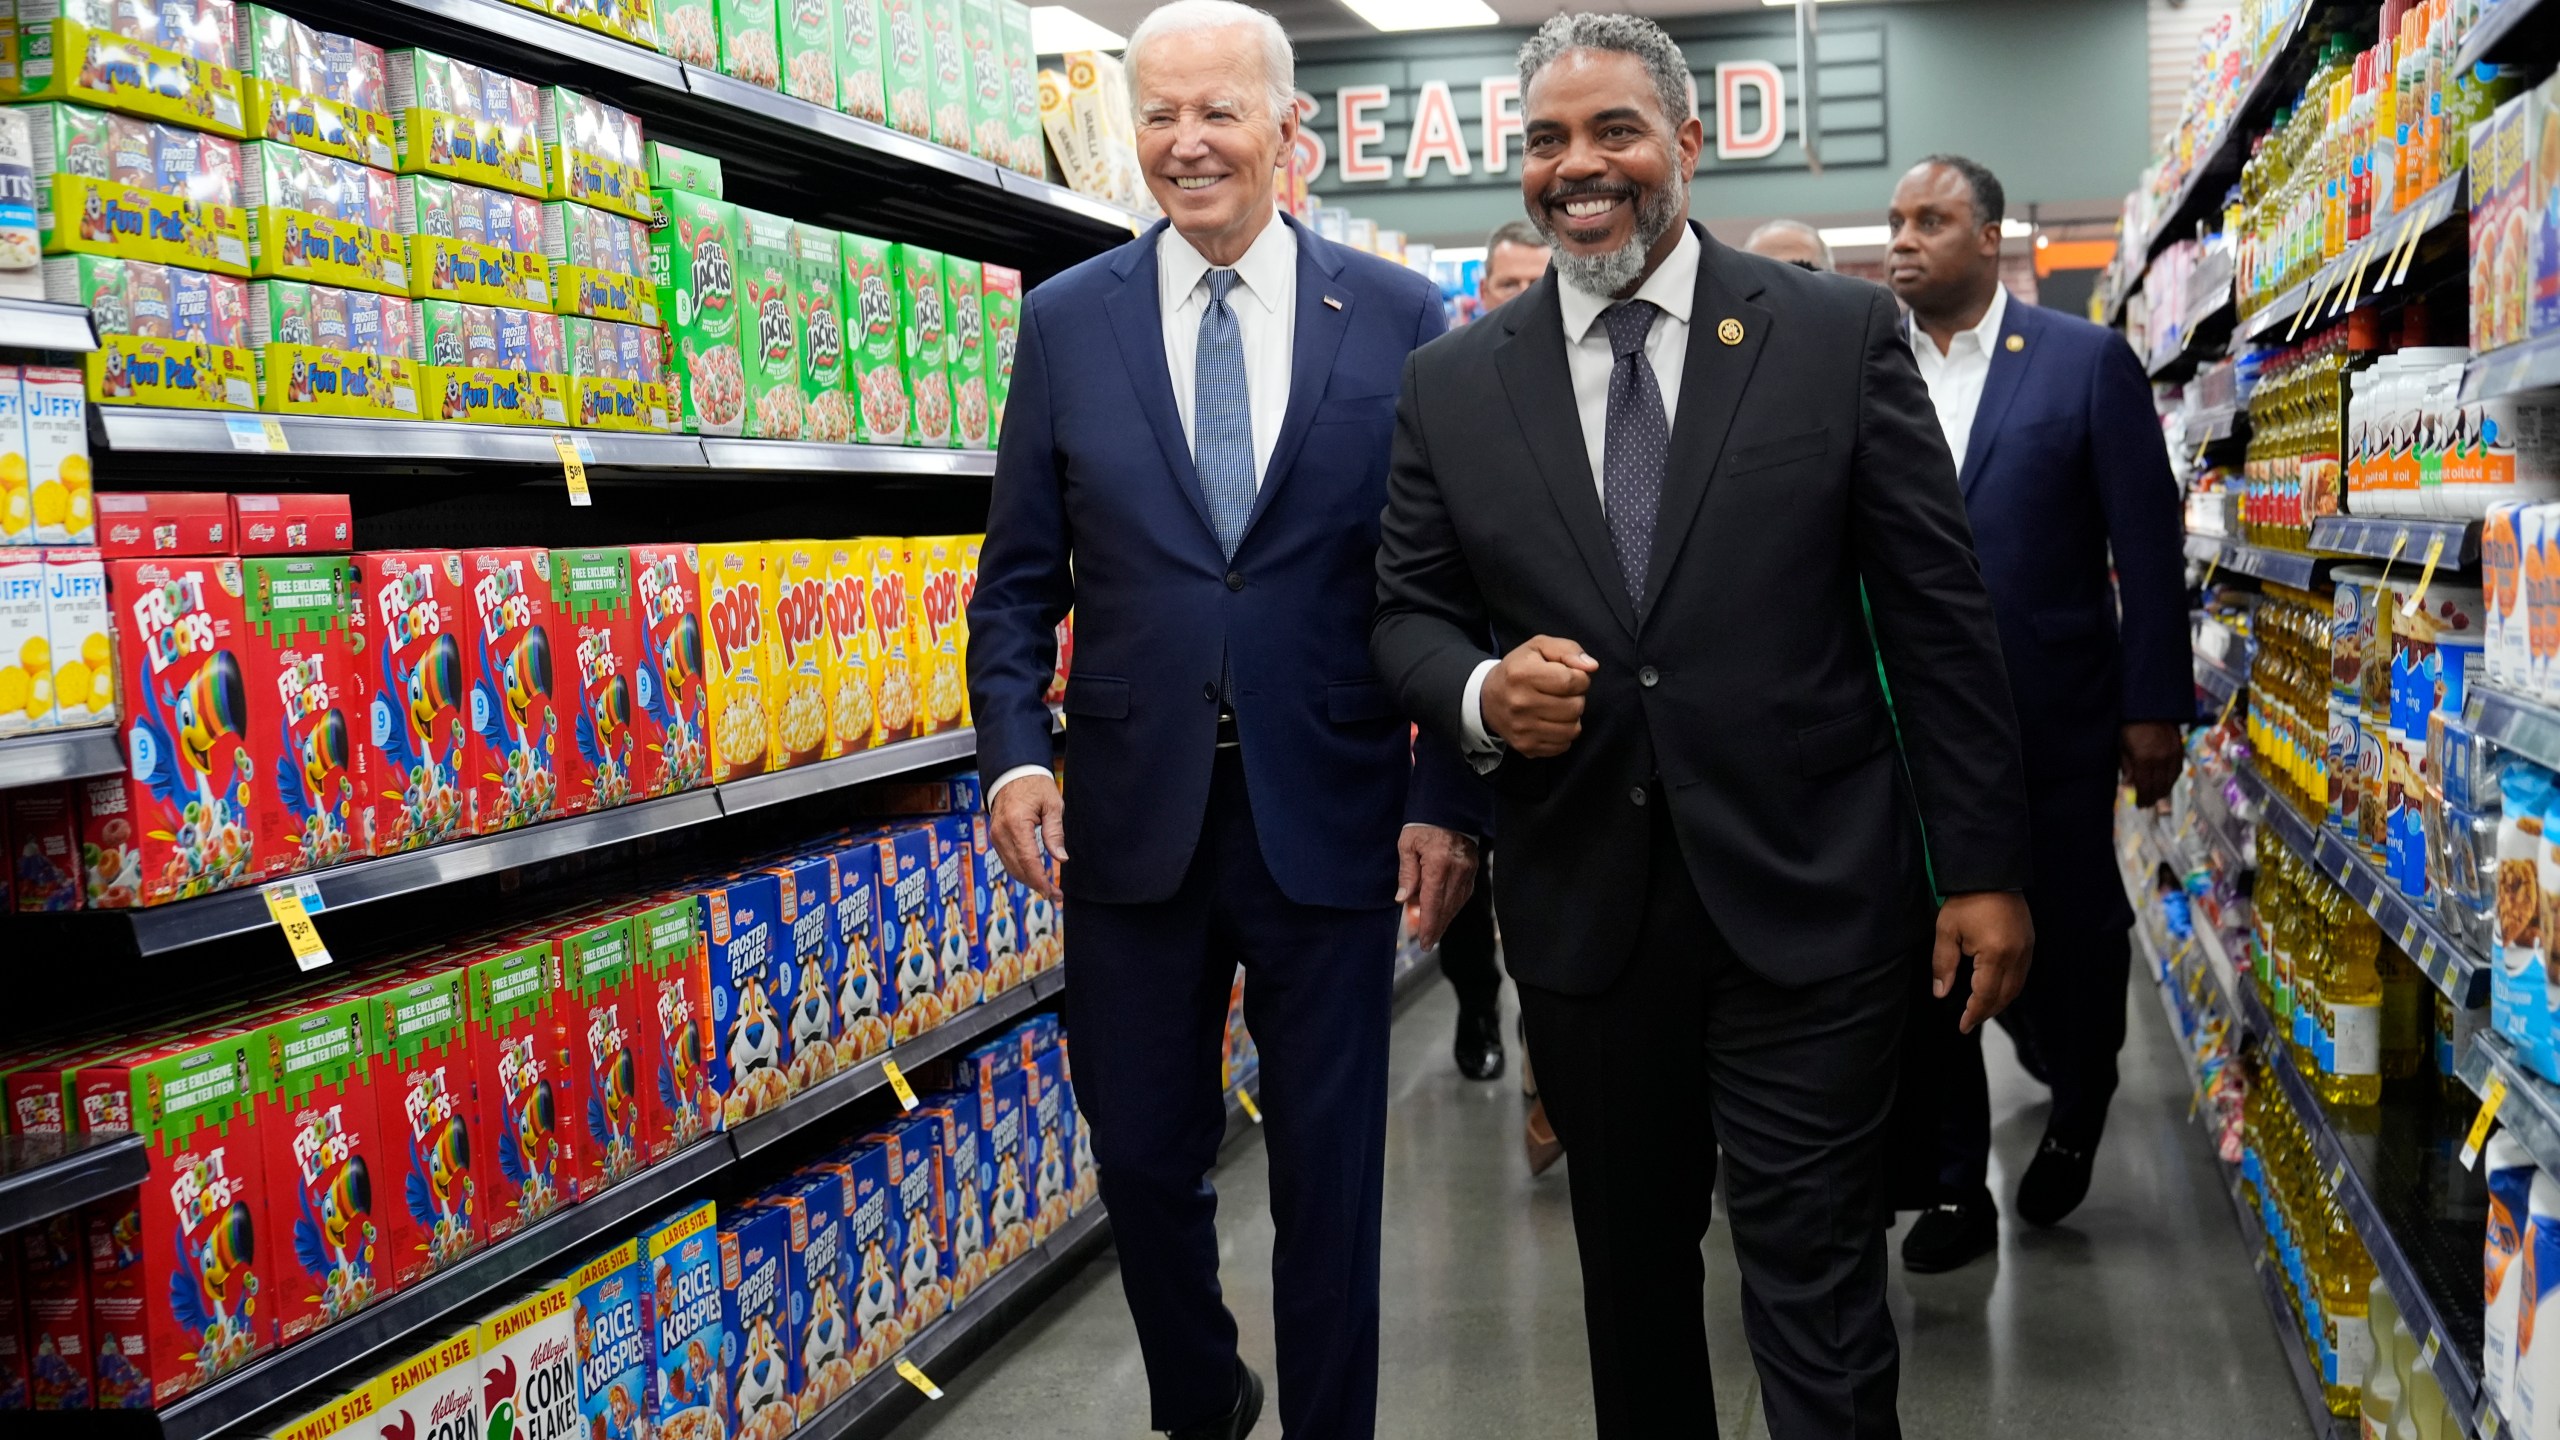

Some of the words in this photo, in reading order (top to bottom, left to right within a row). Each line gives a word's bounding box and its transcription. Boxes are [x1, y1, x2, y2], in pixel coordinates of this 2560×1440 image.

[1084, 109, 1098, 159] VANILLA
[1293, 60, 1786, 184] SEAFD
[1057, 127, 1081, 174] VANILLA
[106, 199, 143, 236] Fun
[150, 208, 186, 242] Pak
[301, 228, 330, 260] Fun
[333, 235, 361, 266] Pak
[698, 243, 723, 262] APPLE
[449, 254, 476, 285] Fun
[479, 258, 505, 288] Pak
[691, 256, 731, 324] JACKS
[863, 277, 883, 294] APPLE
[589, 280, 608, 307] Fun
[609, 284, 628, 310] Pak
[764, 301, 785, 316] APPLE
[919, 287, 935, 302] APPLE
[960, 296, 975, 310] APPLE
[812, 311, 831, 325] APPLE
[859, 291, 891, 345] JACKS
[916, 299, 941, 351] JACKS
[957, 308, 980, 356] JACKS
[759, 314, 792, 372] JACKS
[807, 323, 839, 379] JACKS
[125, 353, 159, 386] Fun
[164, 356, 198, 389] Pak
[307, 362, 336, 394] Fun
[341, 365, 369, 396] Pak
[30, 390, 81, 417] JIFFY
[461, 381, 487, 410] Fun
[493, 383, 519, 410] Pak
[51, 573, 101, 598] JIFFY
[378, 564, 434, 628] FROOT
[473, 560, 524, 619] FROOT
[637, 554, 677, 606] FROOT
[133, 571, 205, 642] FROOT
[387, 599, 441, 655] LOOPS
[483, 594, 531, 645] LOOPS
[645, 584, 684, 631] LOOPS
[776, 578, 825, 669] POPS
[827, 576, 866, 662] POPS
[871, 573, 906, 653] POPS
[922, 570, 958, 649] POPS
[147, 612, 215, 675] LOOPS
[575, 628, 611, 671] FROOT
[708, 582, 762, 677] POPS
[277, 653, 324, 704] FROOT
[581, 651, 615, 690] LOOPS
[285, 682, 329, 727] LOOPS
[377, 709, 386, 730] 9
[477, 699, 485, 716] 9
[138, 738, 149, 761] 9
[837, 884, 869, 920] FROSTED
[894, 867, 926, 901] FROSTED
[898, 884, 925, 916] FLAKES
[793, 902, 825, 941] FROSTED
[795, 921, 825, 957] FLAKES
[840, 902, 869, 935] FLAKES
[727, 921, 768, 962] FROSTED
[731, 941, 766, 980] FLAKES
[657, 978, 685, 1026] FROOT
[662, 1003, 689, 1040] LOOPS
[587, 1004, 618, 1052] FROOT
[592, 1027, 622, 1071] LOOPS
[497, 1034, 534, 1085] FROOT
[505, 1058, 539, 1106] LOOPS
[83, 1090, 127, 1113] FROOT
[88, 1106, 129, 1124] LOOPS
[404, 1066, 446, 1124] FROOT
[412, 1092, 451, 1143] LOOPS
[293, 1104, 342, 1167] FROOT
[170, 1147, 225, 1214] FROOT
[302, 1133, 349, 1187] LOOPS
[900, 1158, 929, 1199] FROSTED
[180, 1177, 232, 1236] LOOPS
[852, 1188, 884, 1231] FROSTED
[902, 1177, 928, 1213] FLAKES
[662, 1222, 690, 1247] LARGE
[690, 1211, 708, 1233] SIZE
[804, 1220, 838, 1267] FROSTED
[856, 1208, 883, 1246] FLAKES
[579, 1258, 610, 1287] LARGE
[611, 1248, 630, 1270] SIZE
[737, 1256, 776, 1306] FROSTED
[807, 1242, 837, 1281] FLAKES
[678, 1262, 711, 1309] RICE
[741, 1279, 775, 1321] FLAKES
[495, 1306, 538, 1341] FAMILY
[541, 1291, 566, 1319] SIZE
[594, 1301, 634, 1352] RICE
[661, 1289, 722, 1354] KRISPIES
[391, 1355, 438, 1395] FAMILY
[442, 1337, 471, 1375] SIZE
[531, 1335, 569, 1371] Kellogg's
[582, 1330, 645, 1401] KRISPIES
[431, 1386, 473, 1426] Kellogg's
[526, 1353, 574, 1415] CORN
[343, 1392, 373, 1424] SIZE
[529, 1393, 577, 1440] FLAKES
